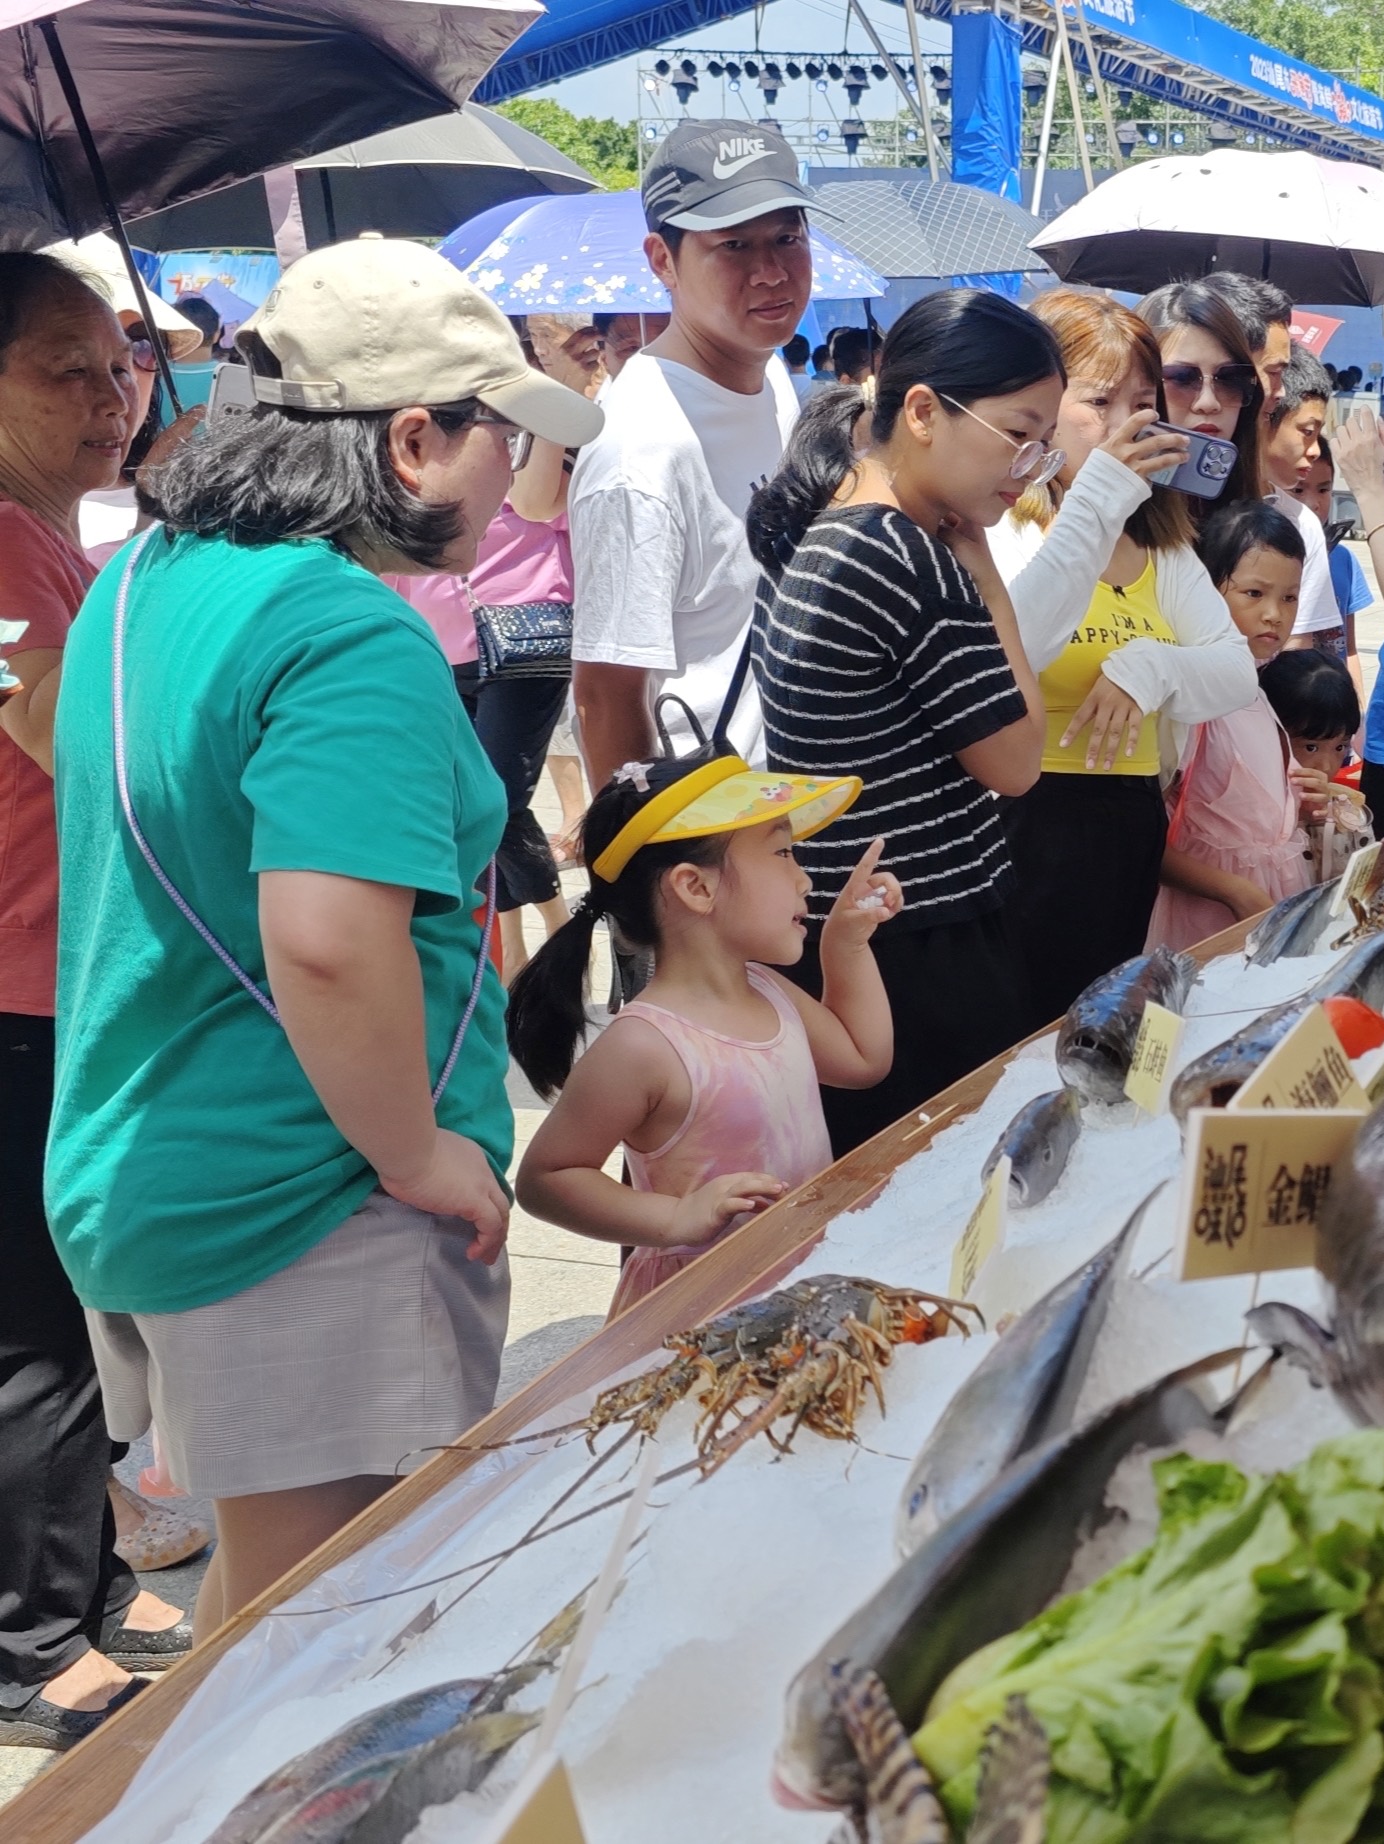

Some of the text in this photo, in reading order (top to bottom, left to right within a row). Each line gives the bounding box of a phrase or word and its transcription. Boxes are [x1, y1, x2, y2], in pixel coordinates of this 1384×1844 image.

[719, 137, 765, 161] NIKE
[1111, 612, 1154, 632] I'M A
